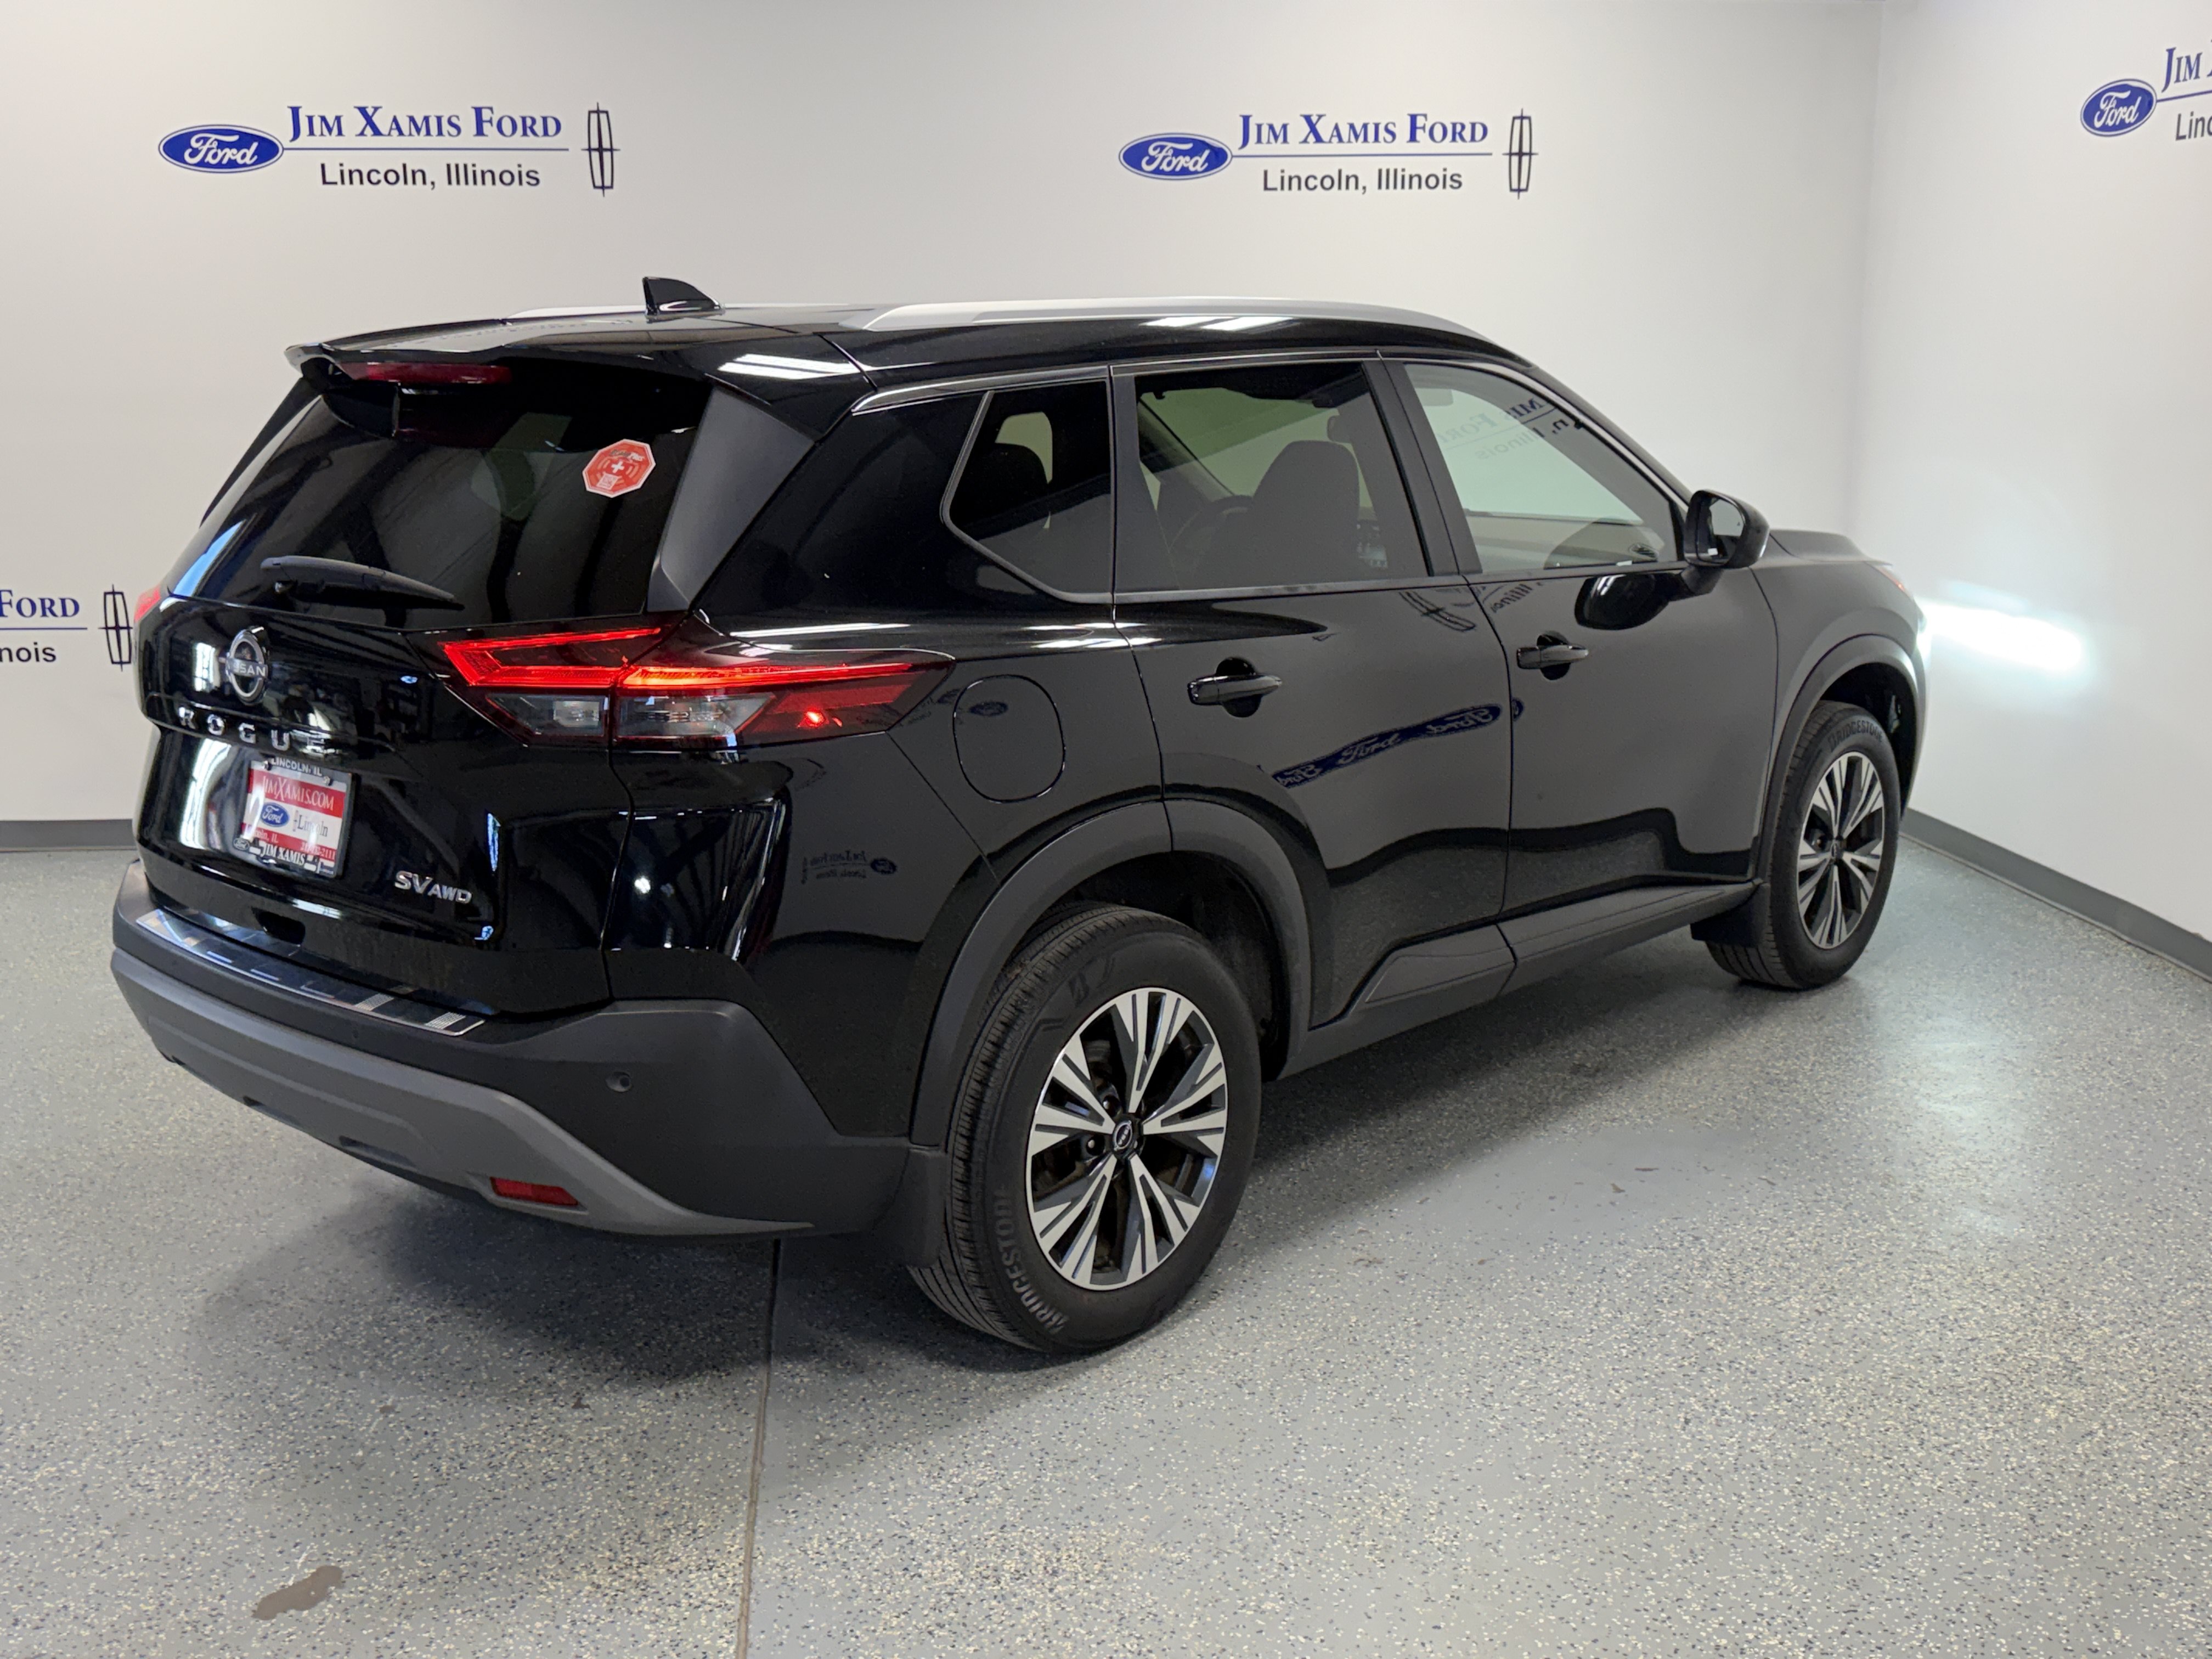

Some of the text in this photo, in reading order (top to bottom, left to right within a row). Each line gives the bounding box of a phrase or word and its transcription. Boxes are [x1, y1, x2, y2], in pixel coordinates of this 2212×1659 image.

[2162, 47, 2202, 93] JIM
[288, 106, 562, 142] JIM XAMIS FORD
[2094, 90, 2142, 128] Ford
[1238, 114, 1488, 150] JIM XAMIS FORD
[183, 132, 258, 166] Ford
[1141, 141, 1209, 173] Ford
[321, 163, 540, 190] Lincoln, Illinois
[1263, 167, 1463, 195] Lincoln, Illinois
[0, 589, 80, 618] FORD
[178, 706, 327, 755] ROGUE
[312, 767, 323, 776] IL
[263, 775, 334, 811] JIMXAMIS.COM
[261, 805, 282, 823] Ford
[297, 815, 329, 837] Linoln
[260, 843, 307, 866] JIM XAMIS
